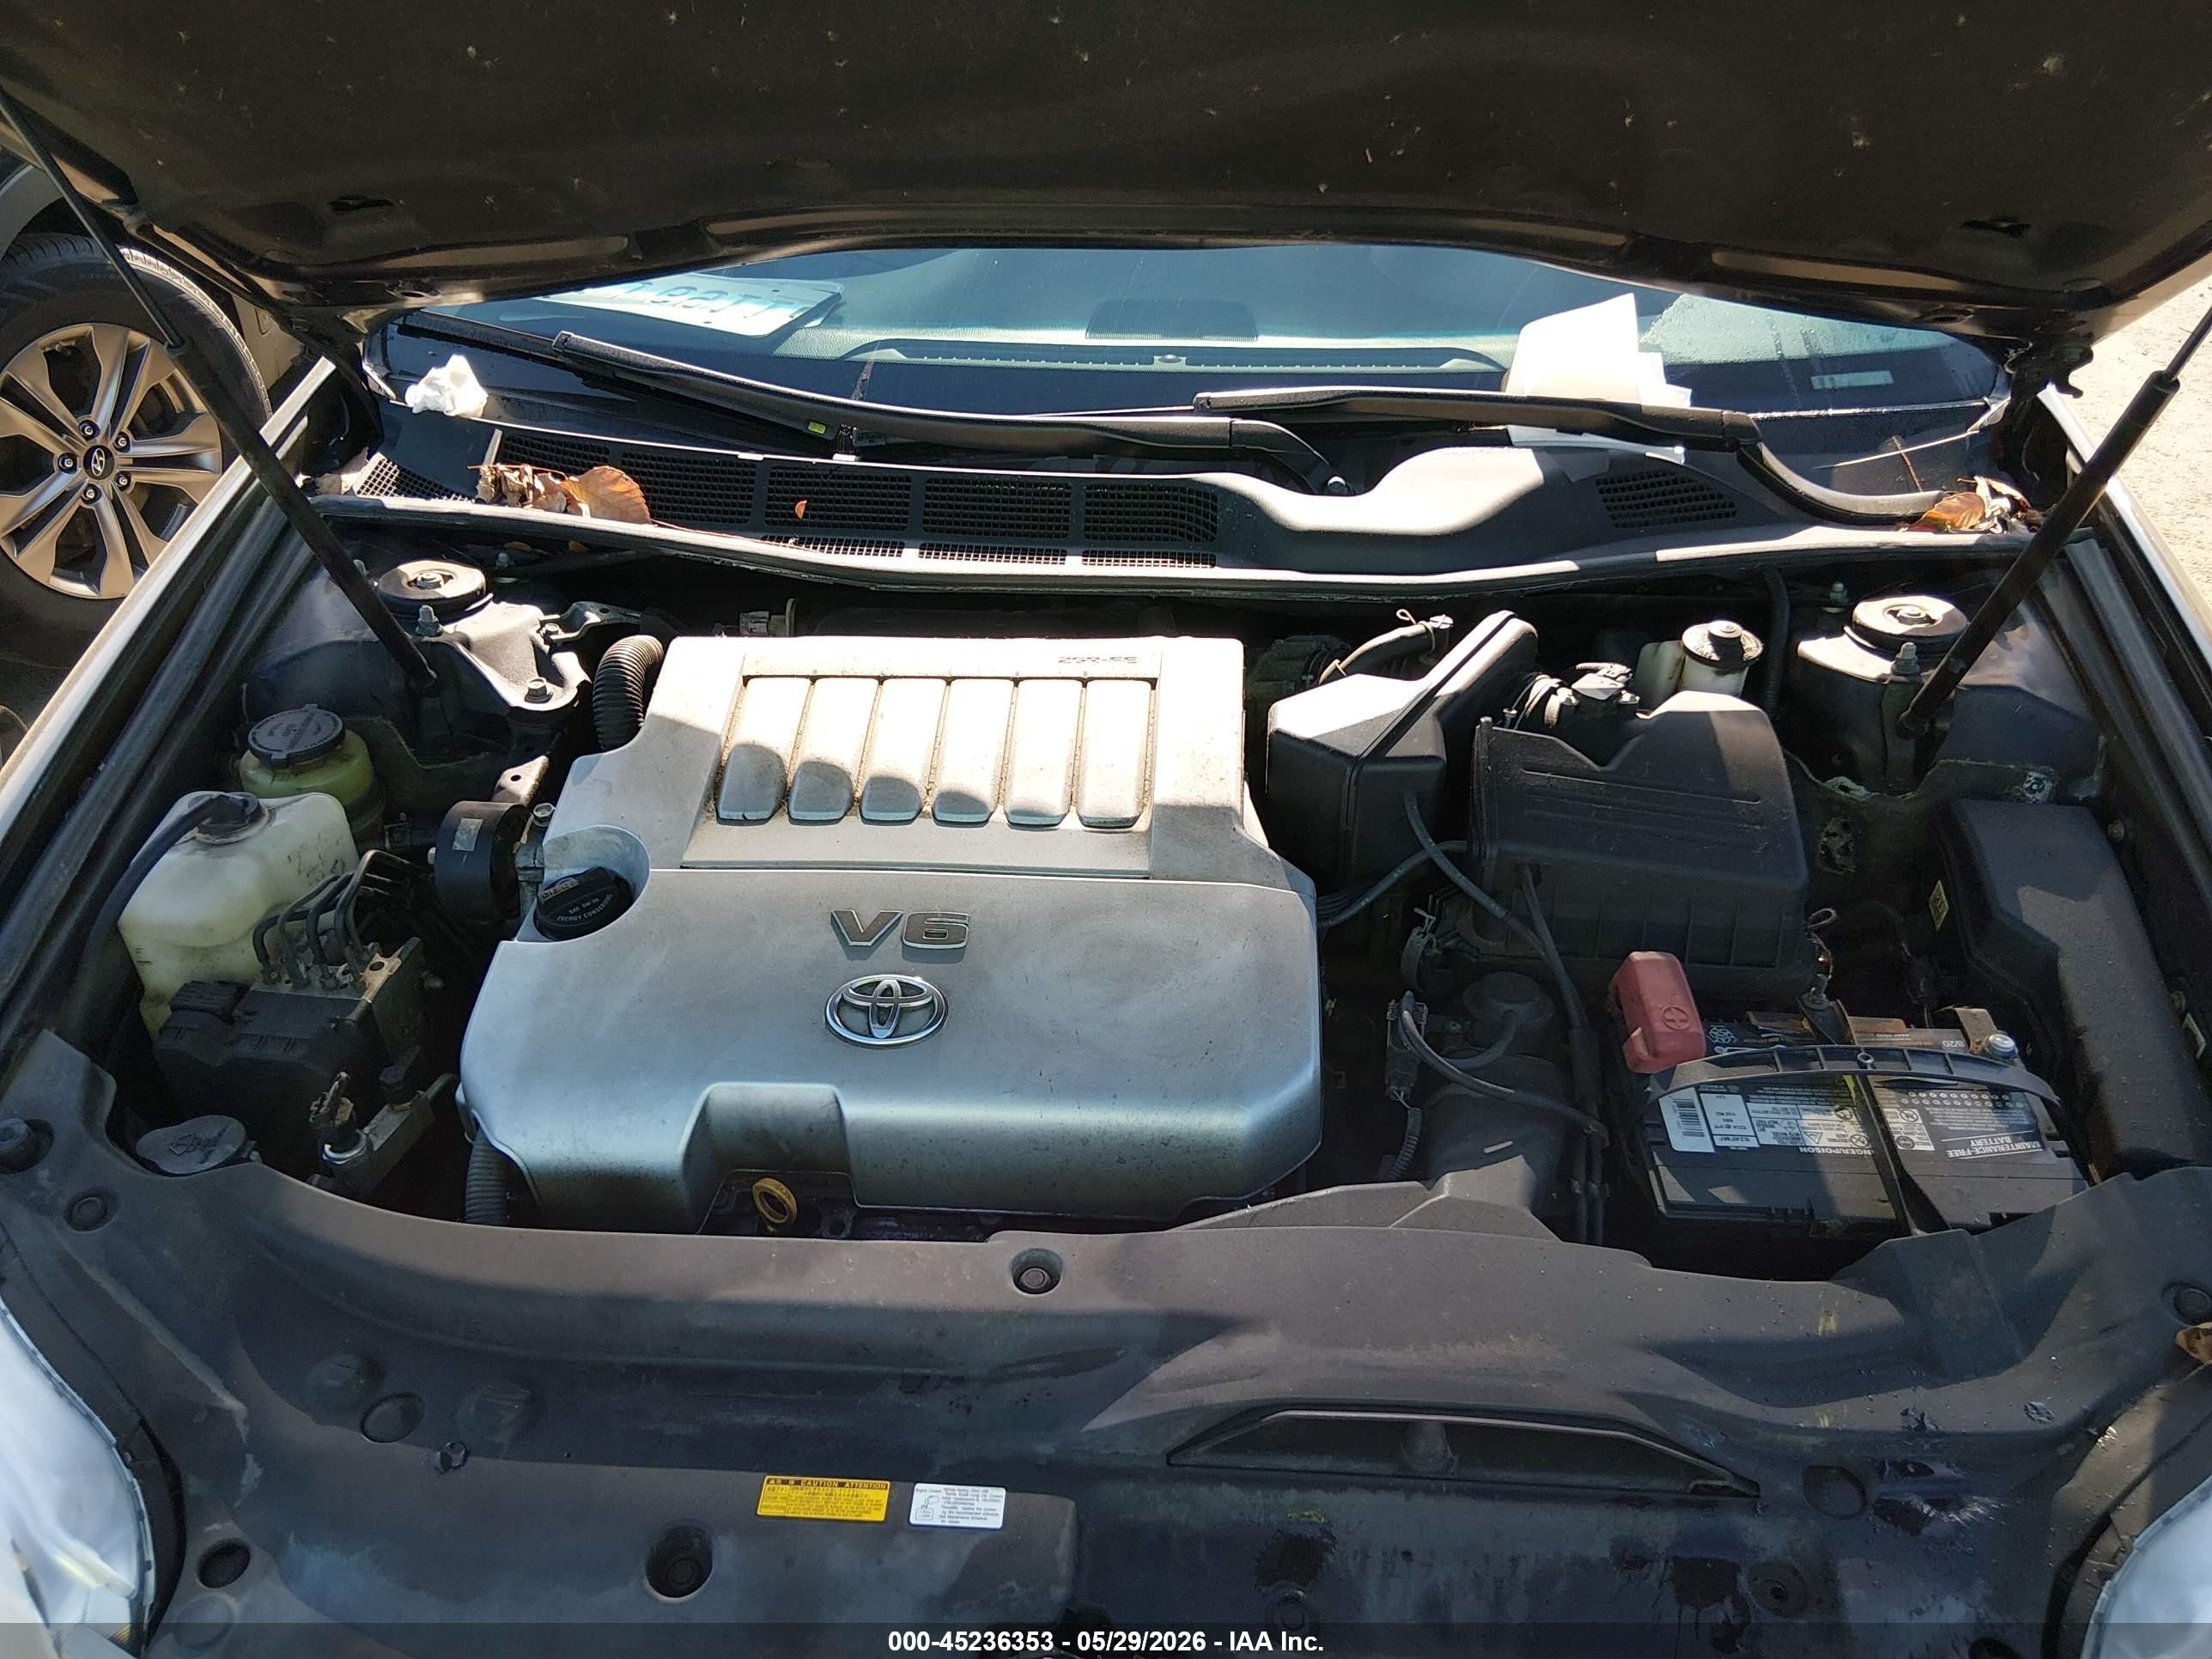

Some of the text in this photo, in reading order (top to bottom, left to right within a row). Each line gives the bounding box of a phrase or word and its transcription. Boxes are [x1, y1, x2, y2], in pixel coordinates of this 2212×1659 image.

[830, 909, 971, 955] V6
[1970, 1135, 2012, 1147] BATTERY
[1945, 1140, 2042, 1158] MAINTENANCE-FREE
[800, 1479, 839, 1487] CAUTION
